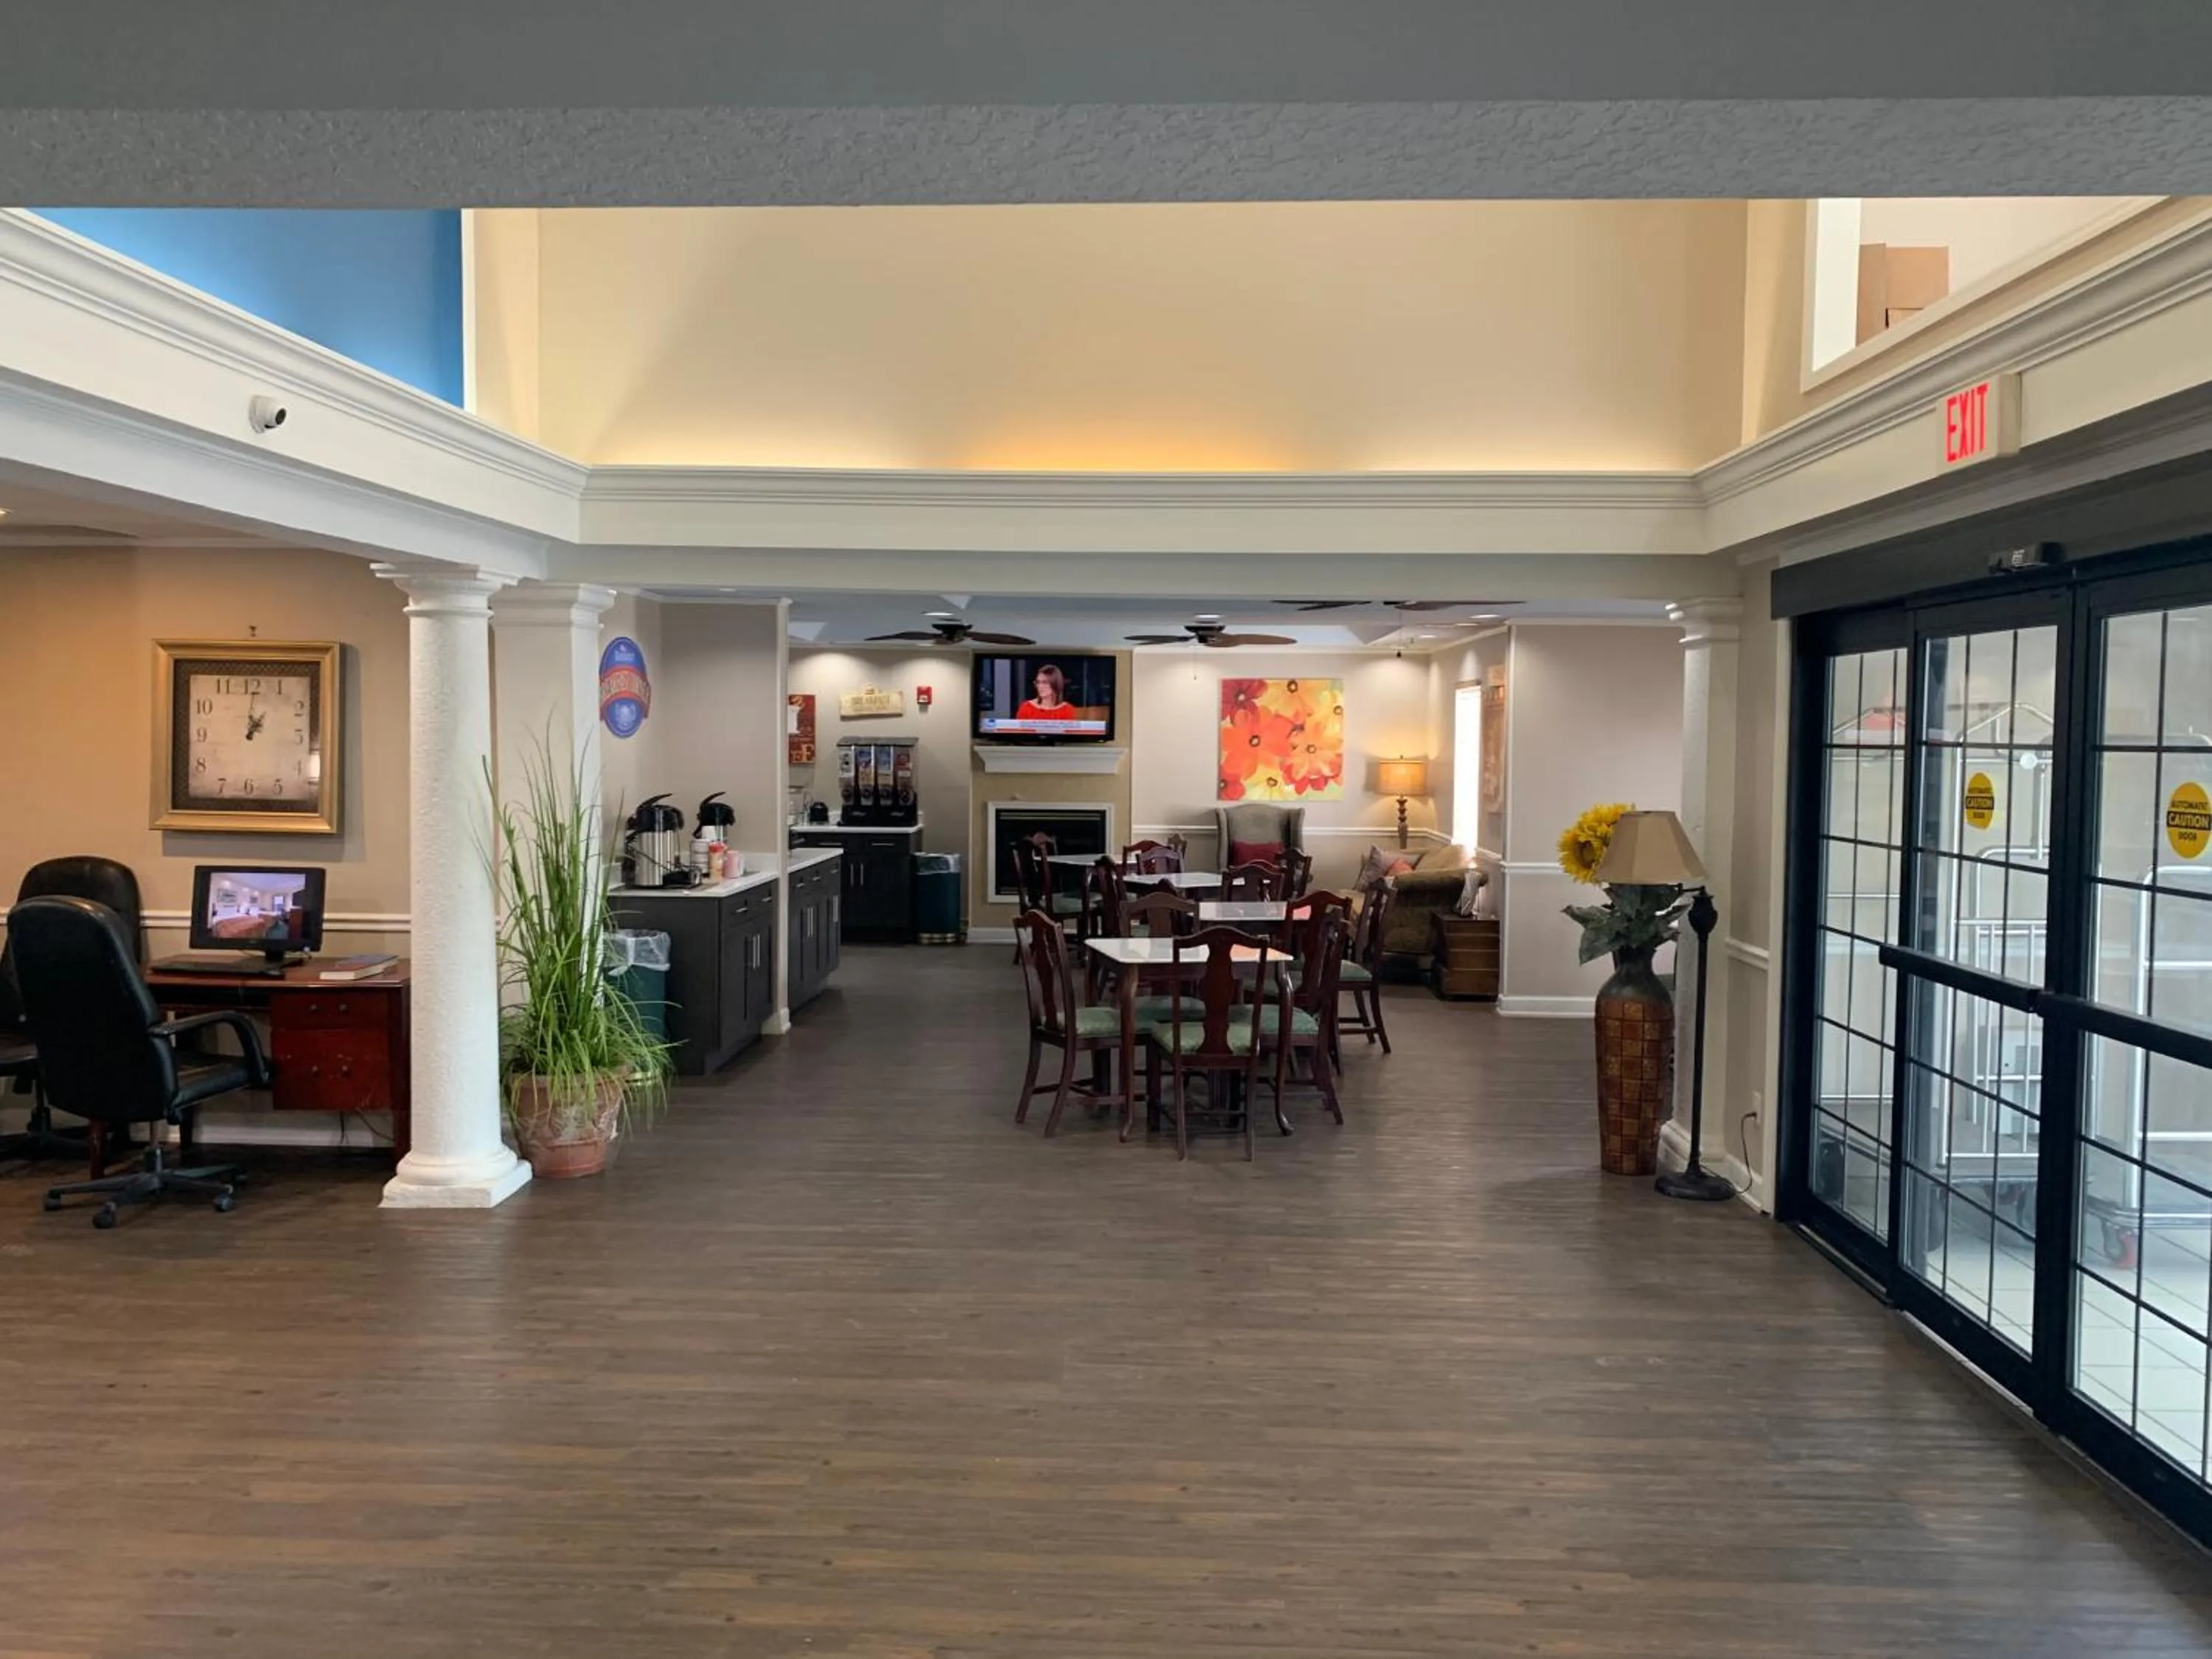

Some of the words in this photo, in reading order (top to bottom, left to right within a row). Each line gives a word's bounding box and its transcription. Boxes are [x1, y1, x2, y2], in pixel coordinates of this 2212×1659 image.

[1947, 383, 1988, 462] EXIT
[216, 678, 230, 694] 11
[243, 678, 260, 695] 12
[277, 679, 282, 695] 1
[196, 699, 213, 714] 10
[294, 700, 305, 717] 2
[196, 728, 207, 742] 9
[195, 757, 206, 773] 8
[218, 778, 226, 794] 7
[244, 779, 254, 794] 6
[274, 779, 283, 795] 5
[2168, 813, 2209, 829] CAUTION
